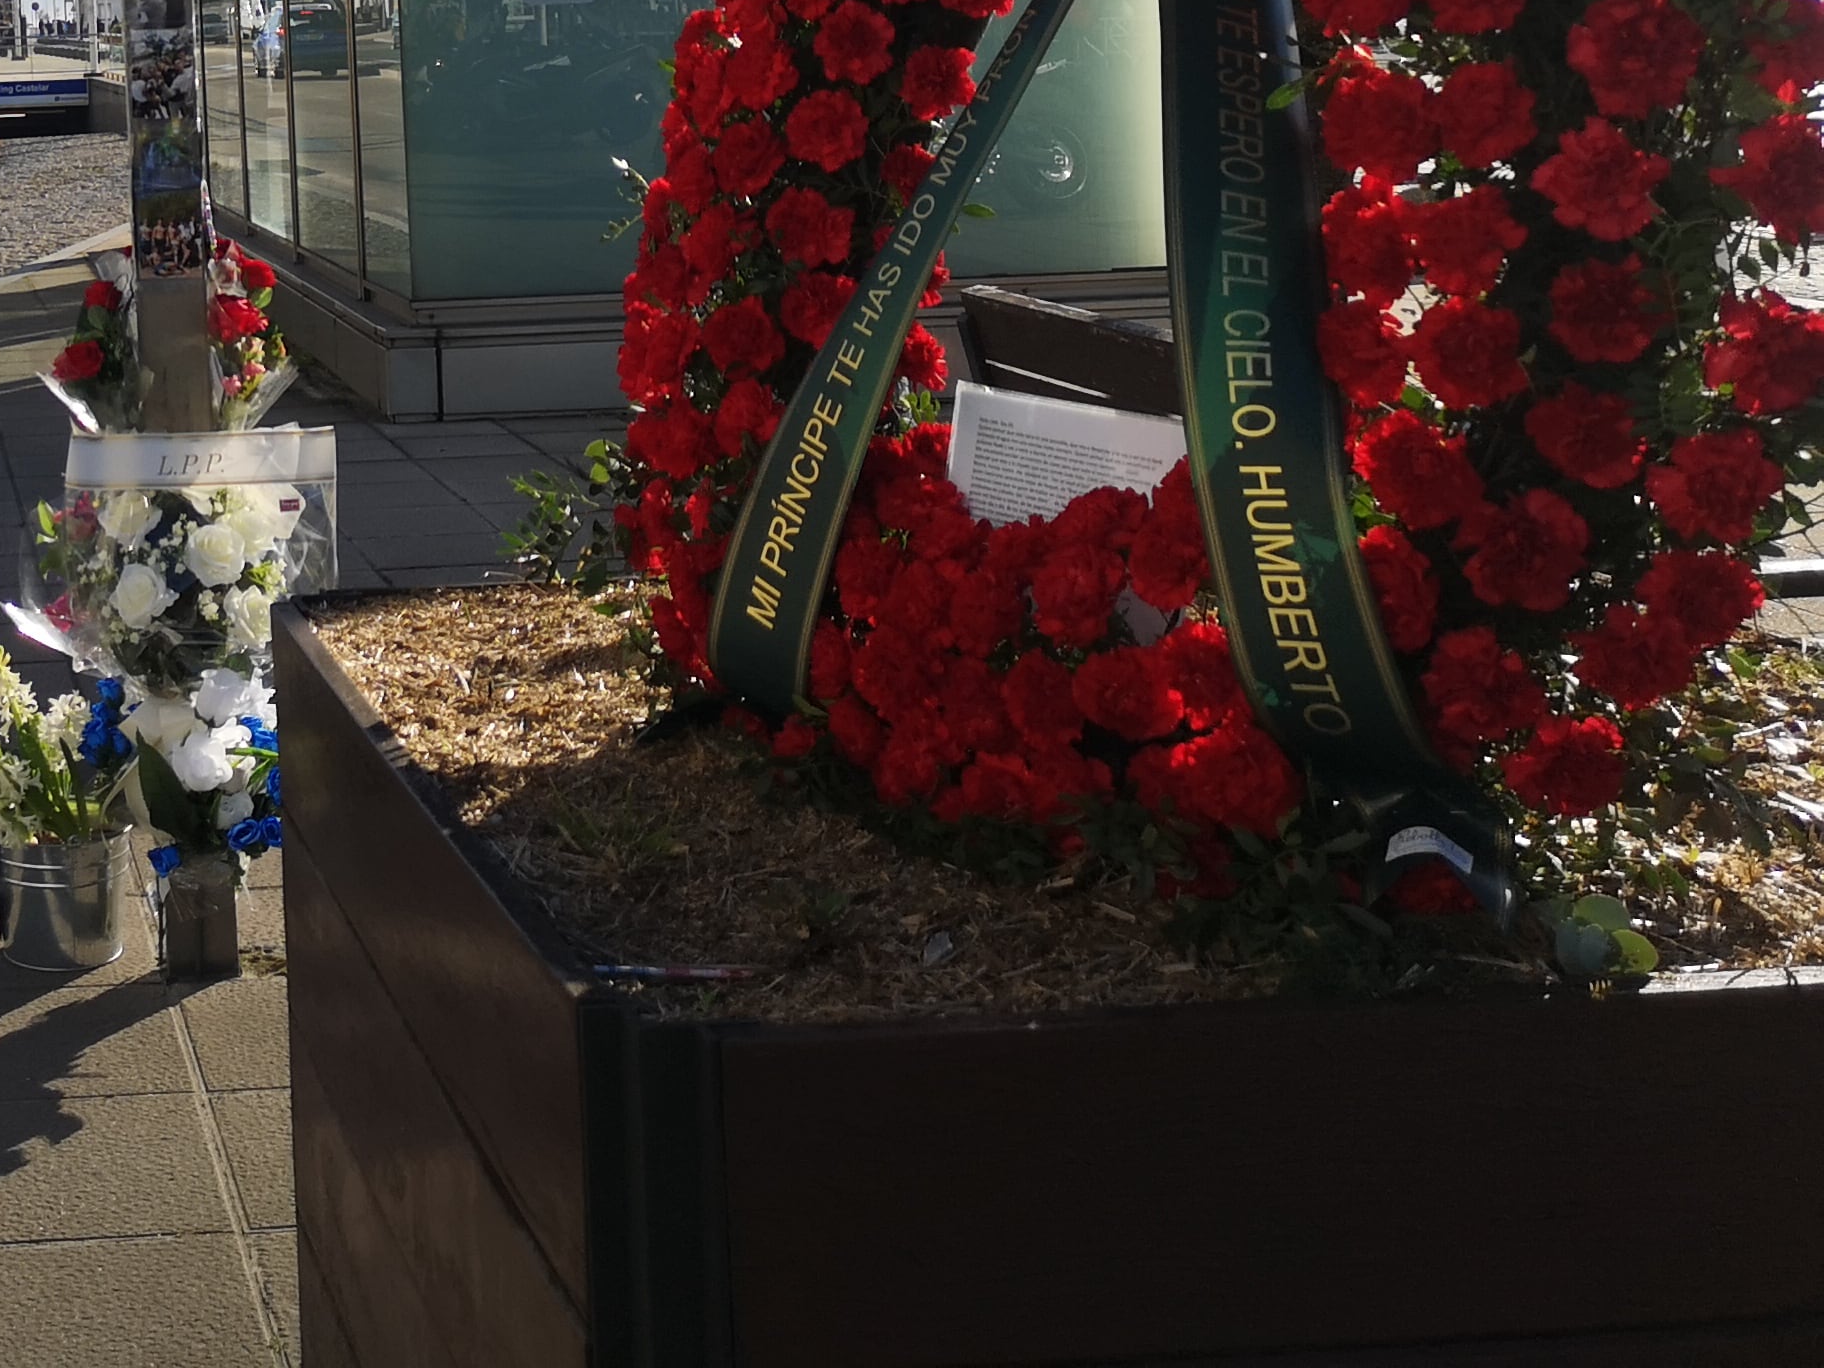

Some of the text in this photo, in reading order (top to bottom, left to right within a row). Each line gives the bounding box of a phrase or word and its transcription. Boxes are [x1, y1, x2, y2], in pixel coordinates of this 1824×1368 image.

[1215, 5, 1259, 45] TE
[15, 83, 50, 93] Castelar
[1217, 45, 1264, 183] ESPERO
[929, 108, 978, 187] MUY
[893, 193, 936, 255] IDO
[1220, 189, 1268, 243] EN
[852, 262, 902, 337] HAS
[1221, 250, 1269, 297] EL
[826, 338, 865, 388] TE
[759, 392, 843, 578] PRÍNCIPE
[745, 574, 782, 630] MI
[1238, 464, 1352, 735] HUMBERTO
